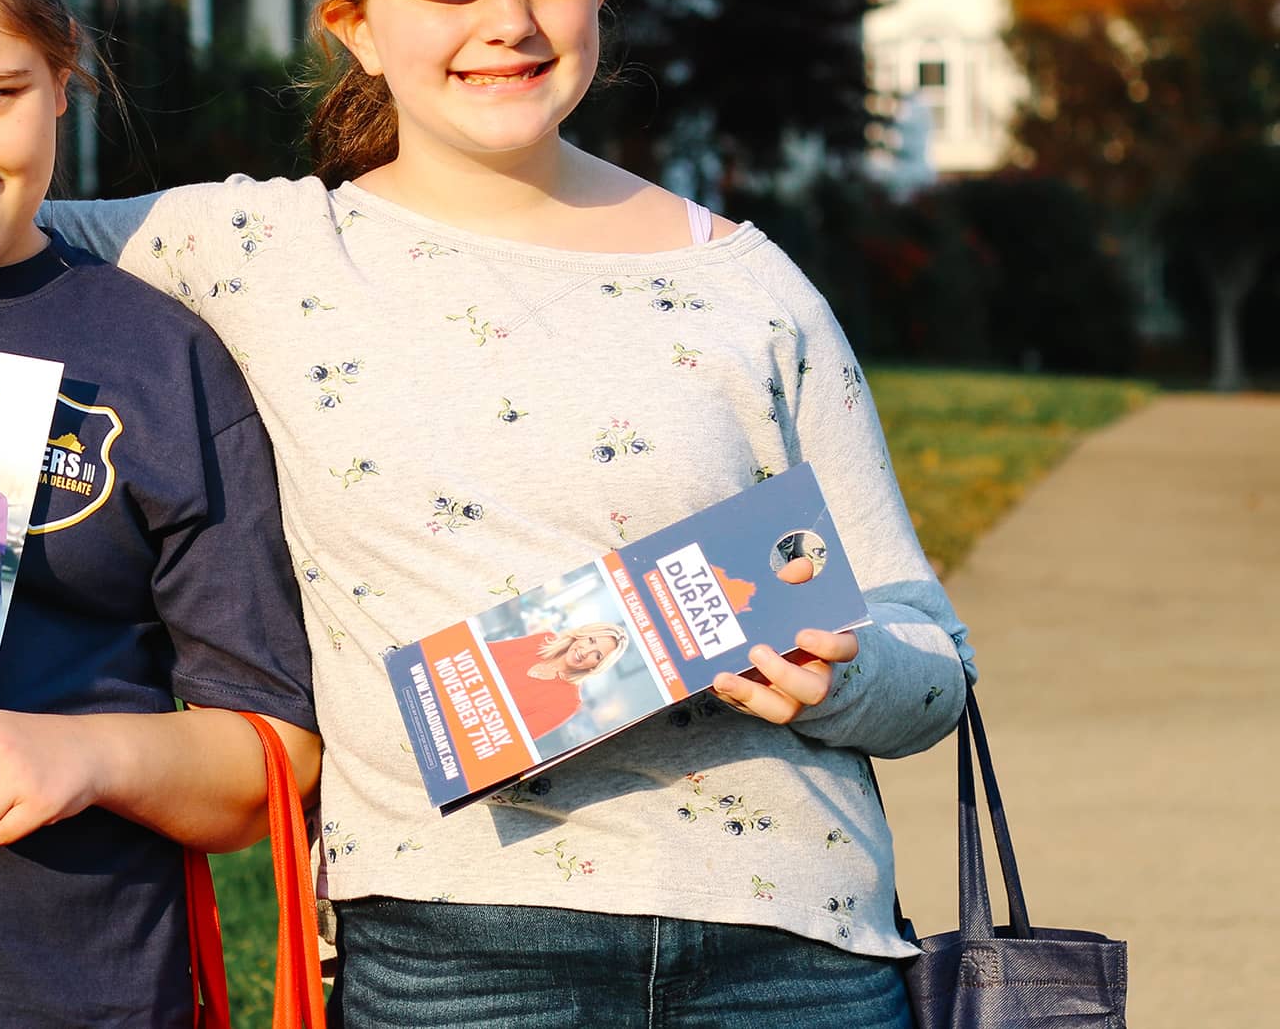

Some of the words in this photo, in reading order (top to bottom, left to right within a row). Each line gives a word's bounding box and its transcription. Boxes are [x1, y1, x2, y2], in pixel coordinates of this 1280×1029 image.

[50, 475, 93, 496] DELEGATE
[82, 462, 96, 483] III
[648, 573, 676, 619] VIRGINIA
[671, 618, 696, 657] SENATE
[665, 561, 721, 646] DURANT
[691, 565, 729, 628] TARA
[643, 629, 668, 664] MARINE
[409, 662, 460, 781] WWW.TARADURANT.COM
[434, 656, 480, 729] NOVEMBER
[467, 726, 496, 760] 7TH!
[453, 649, 484, 688] VOTE
[470, 684, 513, 753] TUESDAY,
